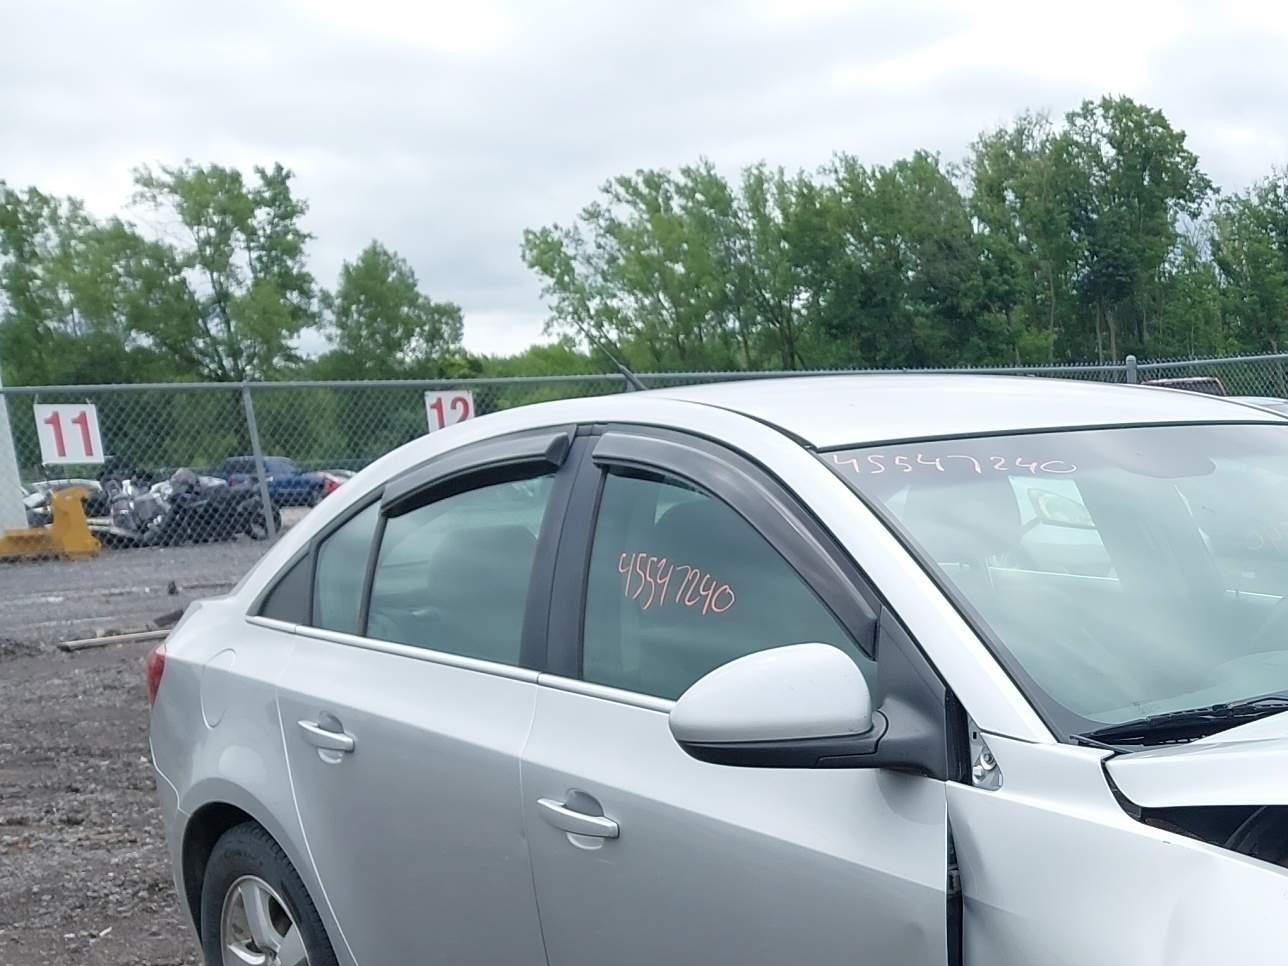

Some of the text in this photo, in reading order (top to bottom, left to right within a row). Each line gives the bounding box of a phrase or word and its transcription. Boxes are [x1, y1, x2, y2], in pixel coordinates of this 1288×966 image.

[430, 396, 469, 430] 12
[43, 410, 94, 457] 11
[833, 454, 1077, 474] 45547240
[618, 552, 735, 616] 45547240
